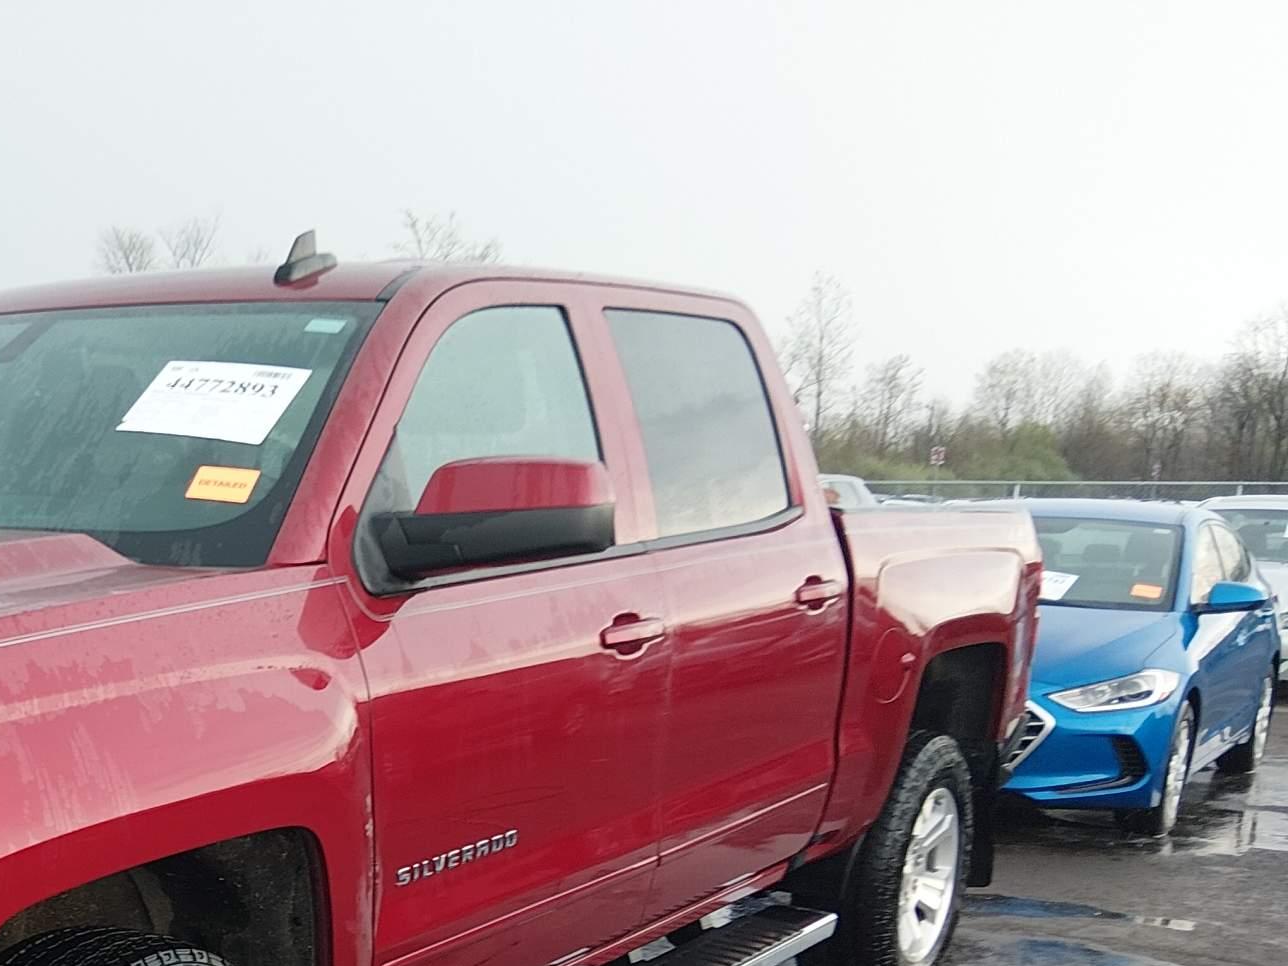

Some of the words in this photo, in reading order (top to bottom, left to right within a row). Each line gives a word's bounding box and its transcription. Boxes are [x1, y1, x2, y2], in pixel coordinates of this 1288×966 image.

[167, 376, 279, 398] 44772893
[199, 479, 248, 489] DETAILED
[394, 829, 518, 886] SILVERADO
